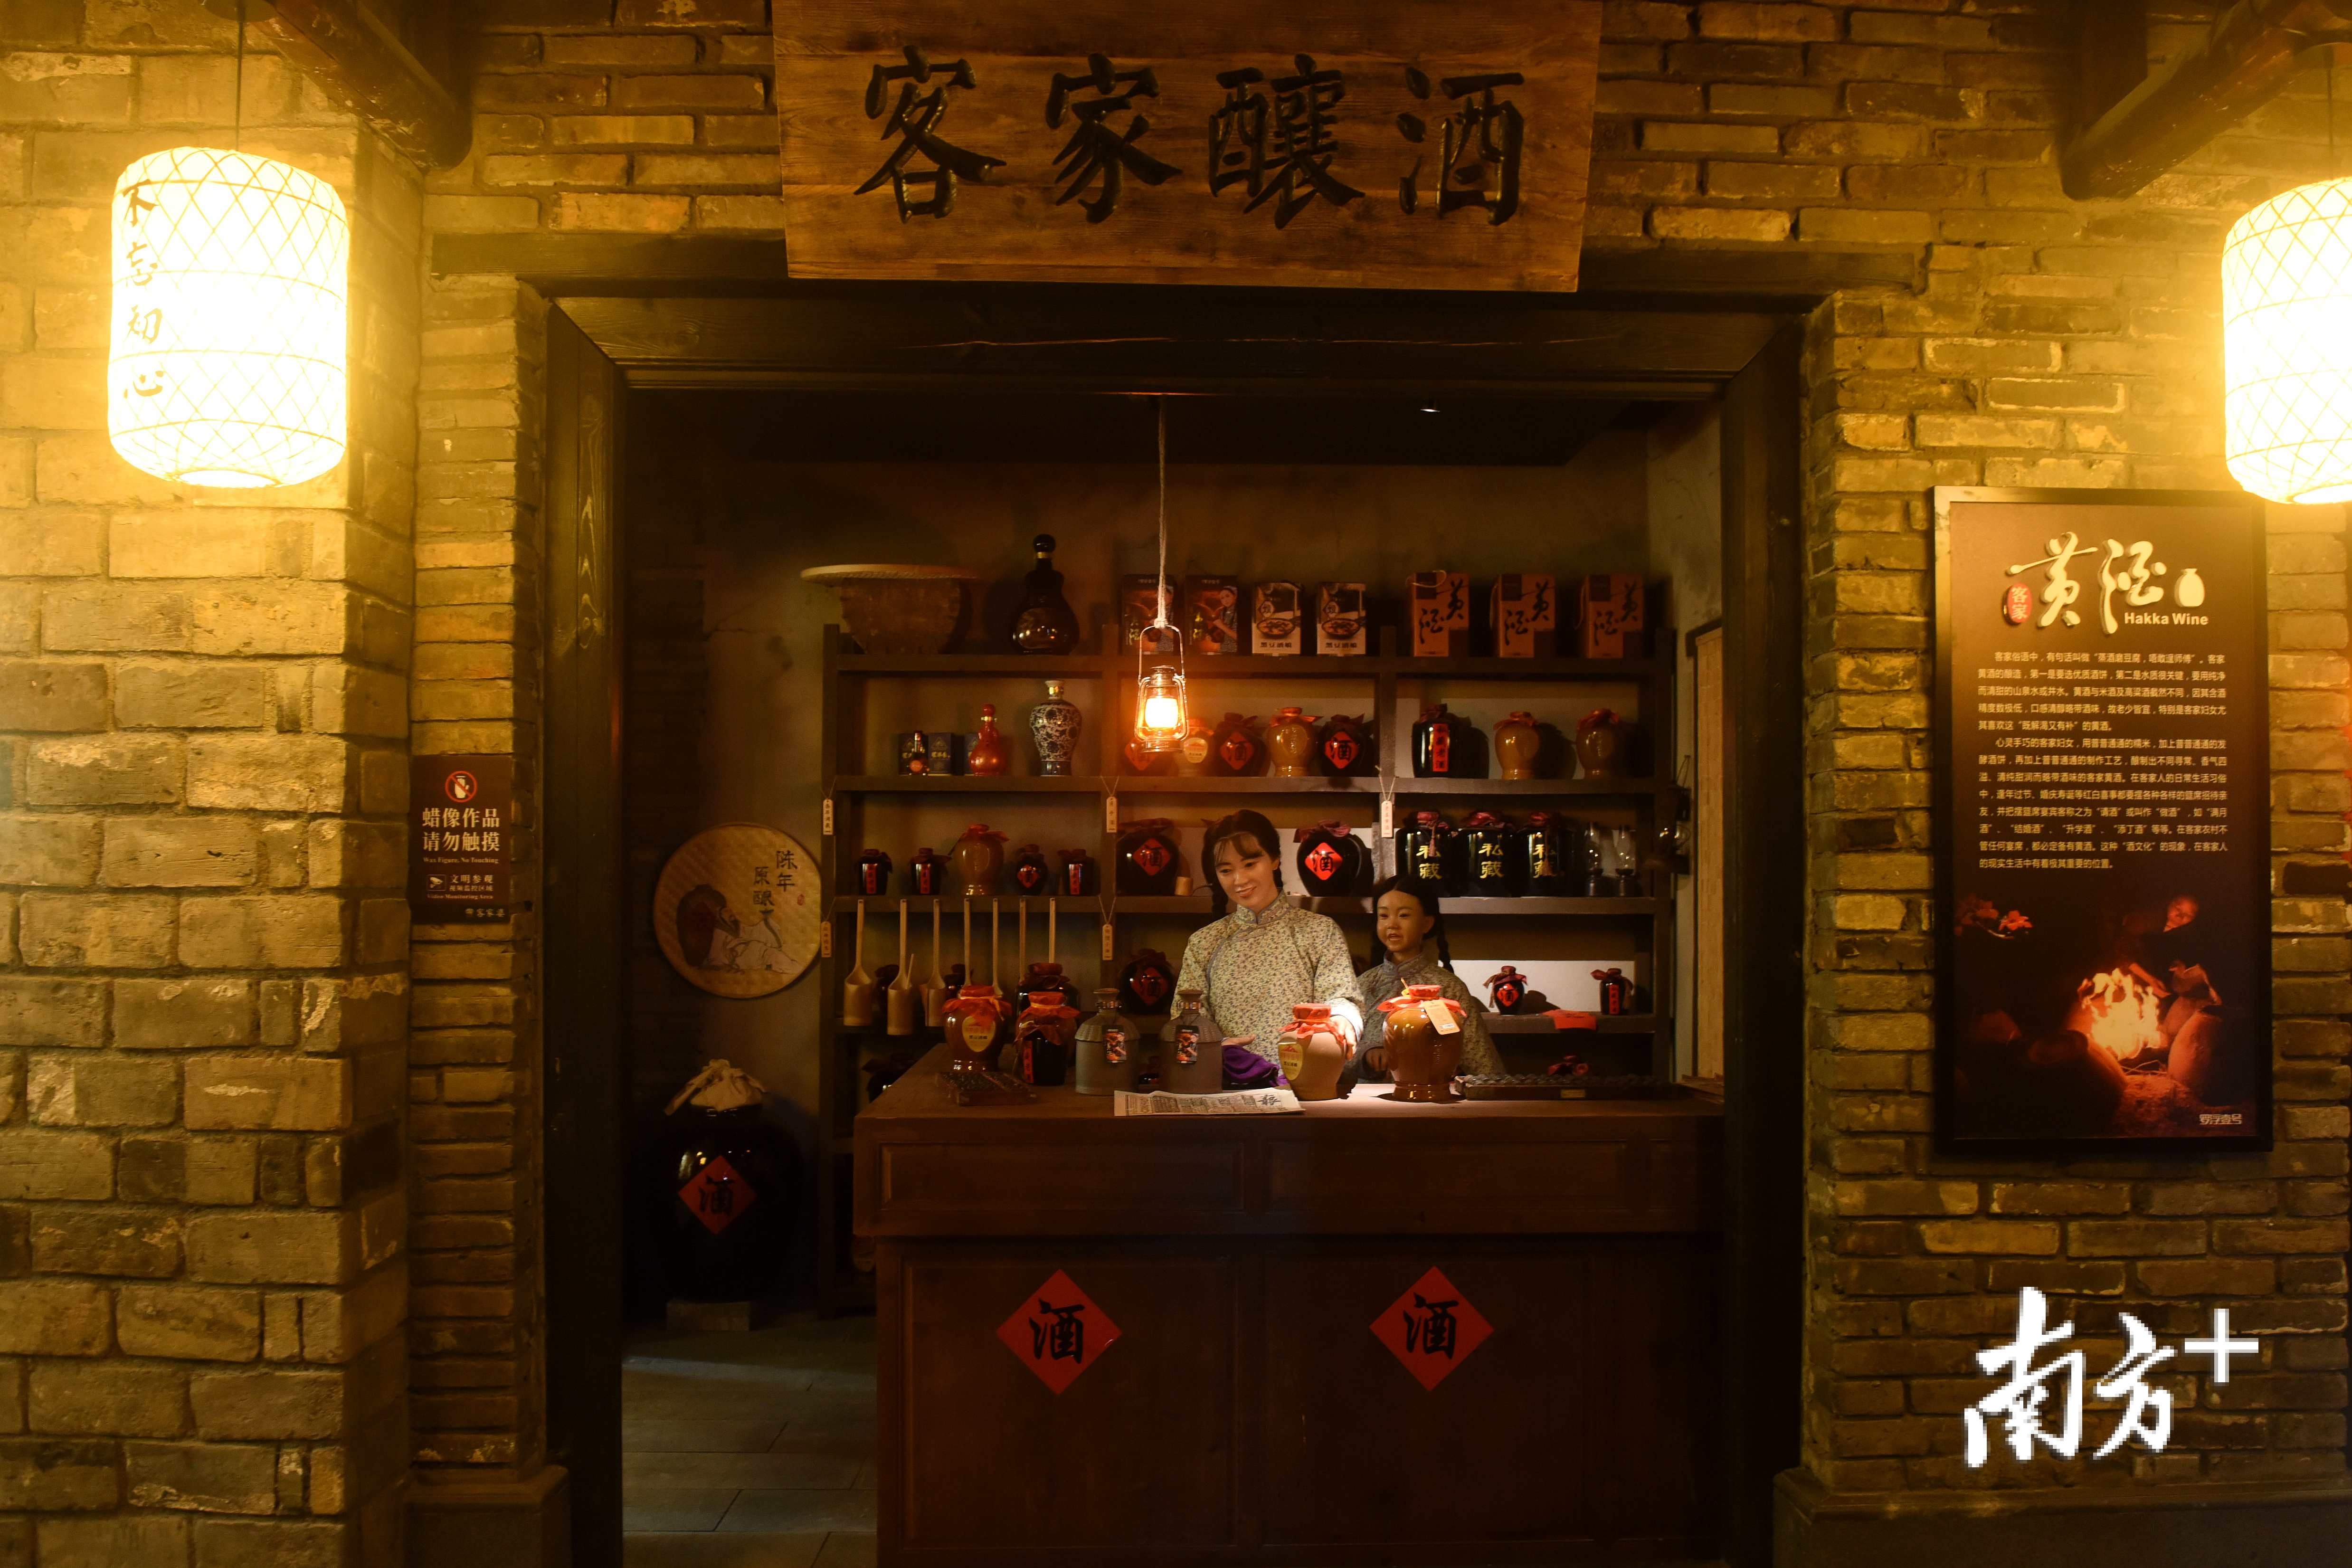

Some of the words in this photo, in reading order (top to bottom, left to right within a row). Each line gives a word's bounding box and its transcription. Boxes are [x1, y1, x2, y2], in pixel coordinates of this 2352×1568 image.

[854, 45, 1525, 229] 客家釀酒
[123, 179, 164, 398] 不忘初心
[2010, 586, 2029, 621] 客家
[2124, 612, 2169, 626] Hakka
[2172, 613, 2209, 626] Wine
[1329, 737, 1354, 760] 酒
[422, 808, 500, 828] 蜡像作品
[423, 831, 501, 852] 请勿触摸
[1139, 845, 1163, 868] 酒
[776, 850, 798, 892] 陈年
[1312, 850, 1335, 873] 酒
[1416, 845, 1443, 879] 私藏
[1478, 843, 1505, 879] 私藏
[698, 1175, 737, 1216] 酒
[1028, 1297, 1085, 1365] 酒
[1403, 1292, 1459, 1360] 酒
